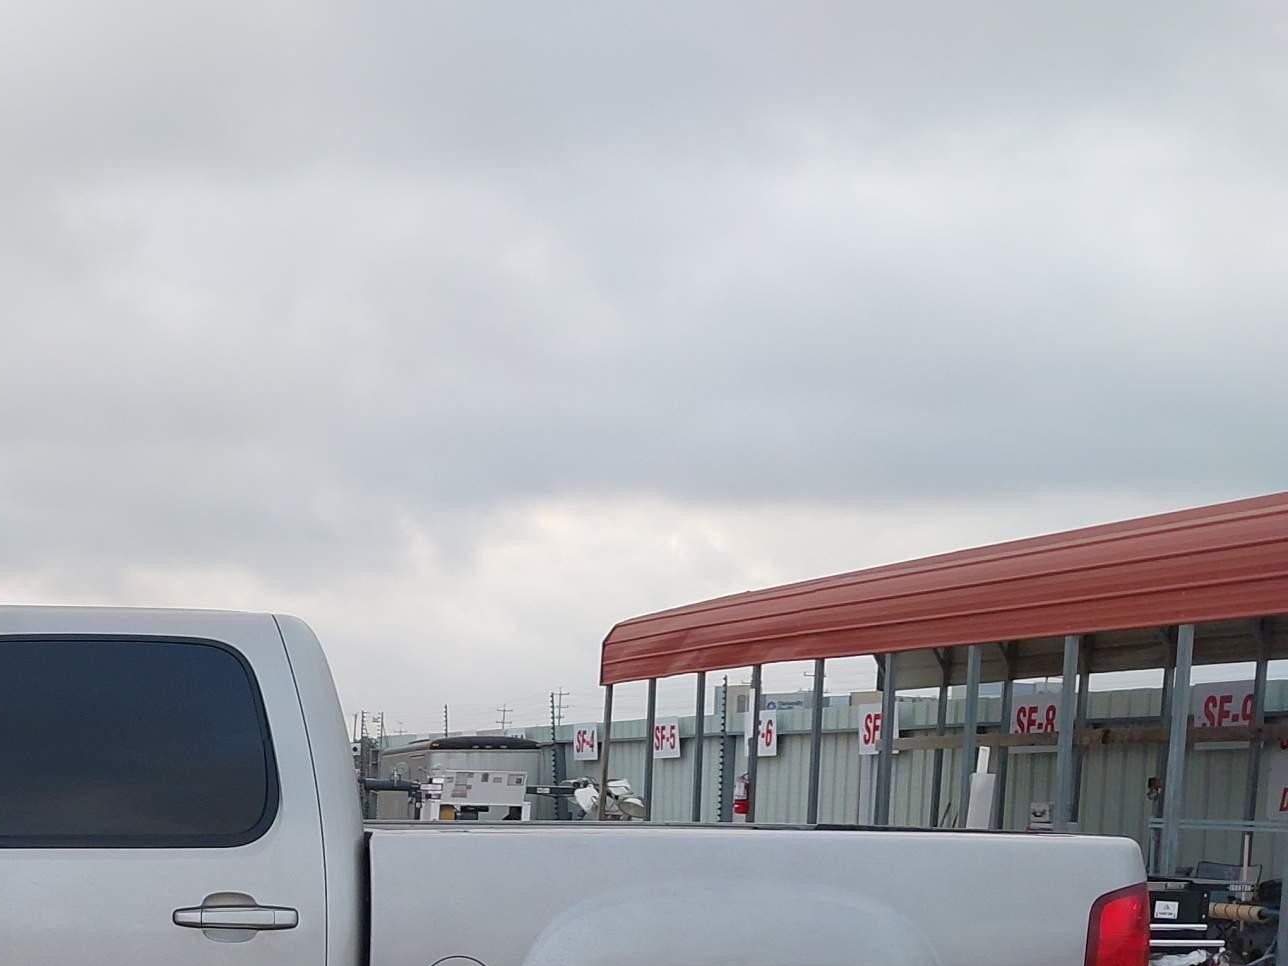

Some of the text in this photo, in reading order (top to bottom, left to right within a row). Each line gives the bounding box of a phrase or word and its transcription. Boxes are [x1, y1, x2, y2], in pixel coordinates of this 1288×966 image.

[864, 713, 881, 745] SF
[1015, 704, 1057, 734] SF-8
[575, 729, 595, 753] SF-4
[654, 725, 676, 751] SF-5
